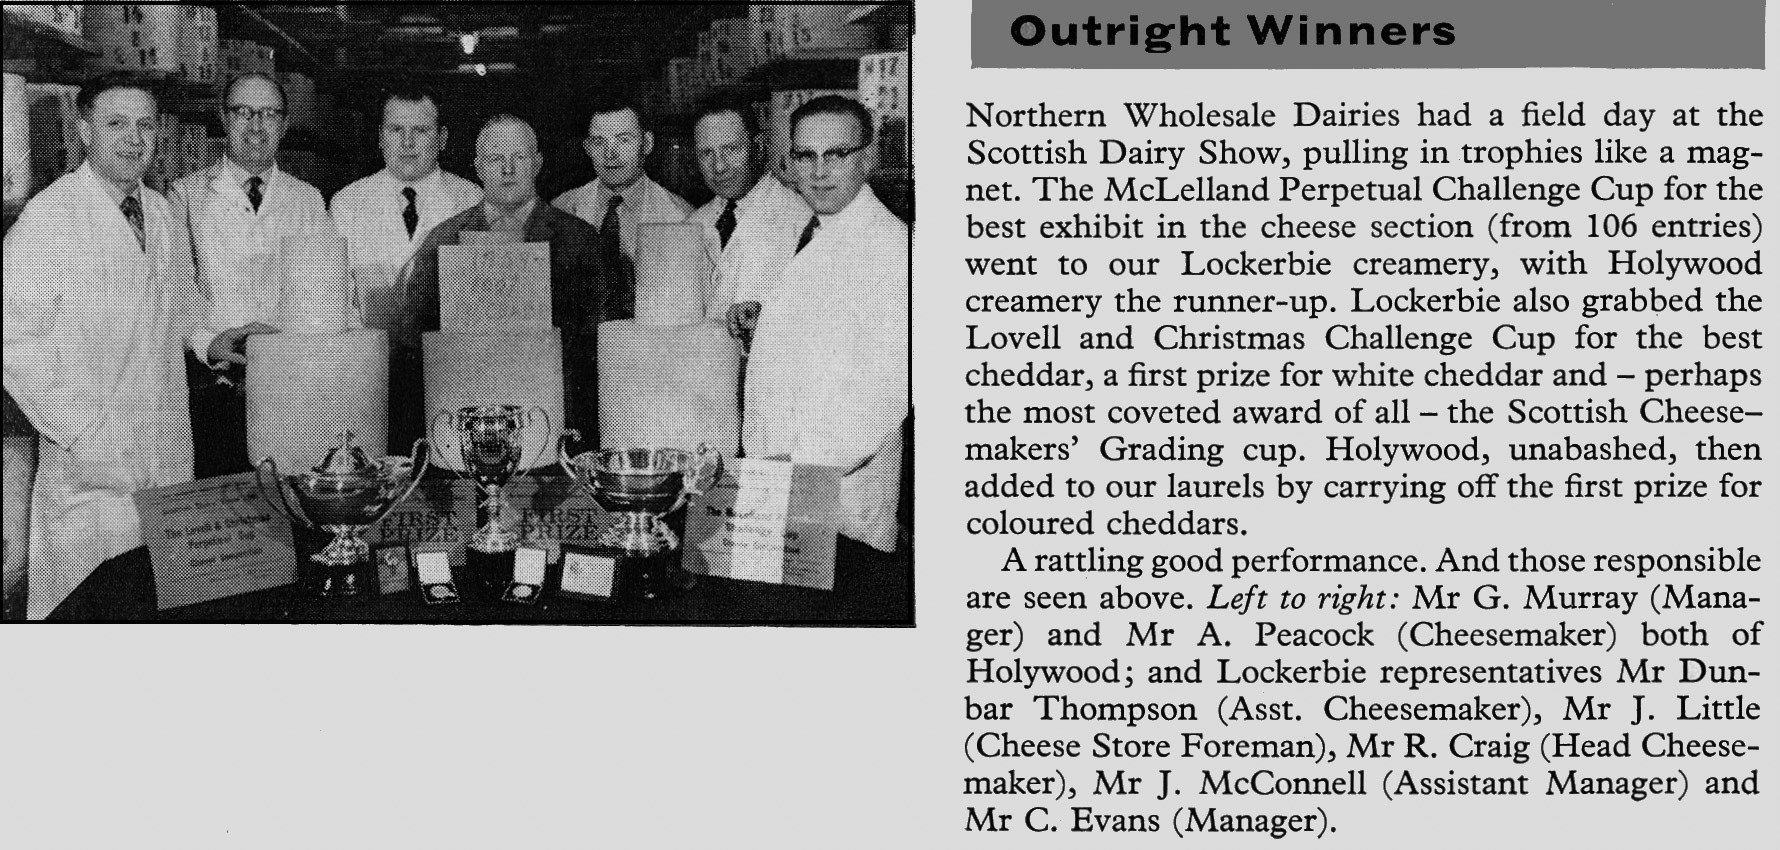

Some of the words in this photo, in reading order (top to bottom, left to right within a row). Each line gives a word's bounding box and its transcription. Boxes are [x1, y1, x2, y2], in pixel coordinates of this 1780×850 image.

[1010, 14, 1231, 54] Outright
[1246, 14, 1456, 46] Winners
[965, 101, 1107, 128] Northern
[1123, 101, 1276, 128] Wholesale
[1293, 101, 1400, 127] Dairies
[1417, 101, 1472, 127] had
[1489, 108, 1505, 127] a
[1521, 100, 1587, 127] field
[1603, 100, 1656, 133] day
[1672, 106, 1700, 127] at
[1716, 100, 1764, 127] the
[967, 138, 1088, 165] Scottish
[1099, 139, 1186, 171] Dairy
[1199, 138, 1291, 170] Show,
[1302, 138, 1409, 171] pulling
[1419, 138, 1450, 164] in
[1460, 138, 1583, 170] trophies
[1594, 137, 1648, 164] like
[1659, 145, 1675, 164] a
[1686, 145, 1763, 170] mag-
[965, 181, 1021, 202] net.
[1031, 175, 1094, 202] The
[1103, 175, 1270, 202] McLelland
[1278, 175, 1423, 208] Perpetual
[1432, 175, 1581, 208] Challenge
[1590, 175, 1654, 207] Cup
[1663, 174, 1708, 201] for
[1715, 175, 1764, 201] the
[965, 213, 1027, 239] best
[1039, 212, 1144, 239] exhibit
[1156, 213, 1187, 239] in
[1199, 213, 1247, 239] the
[1260, 213, 1357, 239] cheese
[1370, 212, 1474, 239] section
[1487, 212, 1572, 244] (from
[1587, 212, 1638, 238] 106
[1651, 212, 1763, 244] entries)
[964, 255, 1038, 276] went
[1057, 255, 1088, 276] to
[1108, 257, 1161, 277] our
[1180, 250, 1332, 277] Lockerbie
[1353, 257, 1499, 282] creamery,
[1519, 249, 1588, 276] with
[1607, 249, 1763, 281] Holywood
[965, 294, 1103, 319] creamery
[1113, 287, 1162, 313] the
[1173, 294, 1337, 319] runner-up.
[1350, 286, 1501, 313] Lockerbie
[1513, 286, 1570, 313] also
[1581, 286, 1704, 319] grabbed
[1714, 286, 1763, 313] the
[965, 324, 1062, 350] Lovell
[1079, 324, 1135, 350] and
[1153, 324, 1305, 351] Christmas
[1324, 323, 1473, 356] Challenge
[1492, 323, 1556, 356] Cup
[1574, 323, 1618, 350] for
[1635, 323, 1683, 350] the
[1702, 323, 1763, 350] best
[965, 361, 1094, 392] cheddar,
[1103, 369, 1119, 387] a
[1127, 361, 1188, 387] first
[1196, 361, 1271, 394] prize
[1279, 361, 1324, 387] for
[1331, 361, 1415, 387] white
[1424, 361, 1544, 387] cheddar
[1552, 361, 1608, 387] and
[1644, 360, 1762, 393] perhaps
[964, 398, 1012, 424] the
[1023, 403, 1096, 424] most
[1107, 398, 1222, 424] coveted
[1232, 398, 1323, 425] award
[1334, 398, 1367, 424] of
[1374, 398, 1411, 424] all
[1446, 398, 1494, 424] the
[1507, 397, 1629, 425] Scottish
[1099, 435, 1225, 468] Grading
[1243, 443, 1306, 468] cup.
[1325, 435, 1490, 468] Holywood,
[1508, 435, 1677, 466] unabashed,
[1695, 434, 1763, 461] then
[964, 472, 1055, 498] added
[1065, 477, 1095, 499] to
[1105, 480, 1157, 499] our
[1166, 472, 1265, 499] laurels
[1275, 473, 1314, 505] by
[1323, 472, 1447, 505] carrying
[1457, 472, 1500, 499] off
[1506, 472, 1554, 499] the
[1564, 472, 1624, 498] first
[1633, 472, 1708, 505] prize
[1718, 471, 1763, 498] for
[381, 510, 458, 527] FIRST
[520, 524, 599, 541] PRIZE
[521, 507, 599, 525] FIRST
[966, 509, 1095, 536] coloured
[1106, 509, 1248, 536] cheddars.
[381, 526, 458, 543] PRIZE
[1000, 546, 1028, 572] A
[1034, 546, 1145, 579] rattling
[1151, 546, 1224, 579] good
[1231, 546, 1427, 579] performance.
[1434, 546, 1500, 573] And
[1507, 546, 1586, 573] those
[1593, 546, 1762, 579] responsible
[966, 591, 1011, 610] are
[1023, 591, 1088, 610] seen
[1099, 584, 1193, 610] above.
[1206, 583, 1269, 616] Left
[1280, 590, 1306, 610] to
[1317, 583, 1400, 616] right:
[1411, 584, 1461, 610] Mr
[1473, 583, 1510, 610] G.
[1522, 584, 1639, 616] Murray
[1650, 583, 1761, 616] (Mana-
[966, 657, 1134, 690] Holywood;
[1147, 658, 1203, 684] and
[1216, 658, 1367, 684] Lockerbie
[1379, 657, 1602, 691] representatives
[1616, 658, 1666, 684] Mr
[1678, 657, 1761, 684] Dun-
[964, 731, 1081, 764] (Cheese
[1092, 732, 1171, 758] Store
[1180, 732, 1337, 765] Foreman),
[1346, 732, 1395, 759] Mr
[1403, 732, 1437, 759] R.
[1449, 732, 1531, 765] Craig
[1540, 732, 1632, 764] (Head
[1641, 731, 1760, 758] Cheese-
[962, 769, 1077, 801] maker),
[1092, 769, 1143, 795] Mr
[1156, 769, 1181, 801] J.
[1198, 769, 1367, 796] McConnell
[1382, 769, 1529, 802] (Assistant
[1545, 769, 1689, 802] Manager)
[1704, 768, 1760, 795] and
[964, 806, 1013, 832] Mr
[1024, 806, 1058, 833] C.
[1070, 806, 1160, 833] Evans
[1172, 806, 1337, 840] (Manager).
